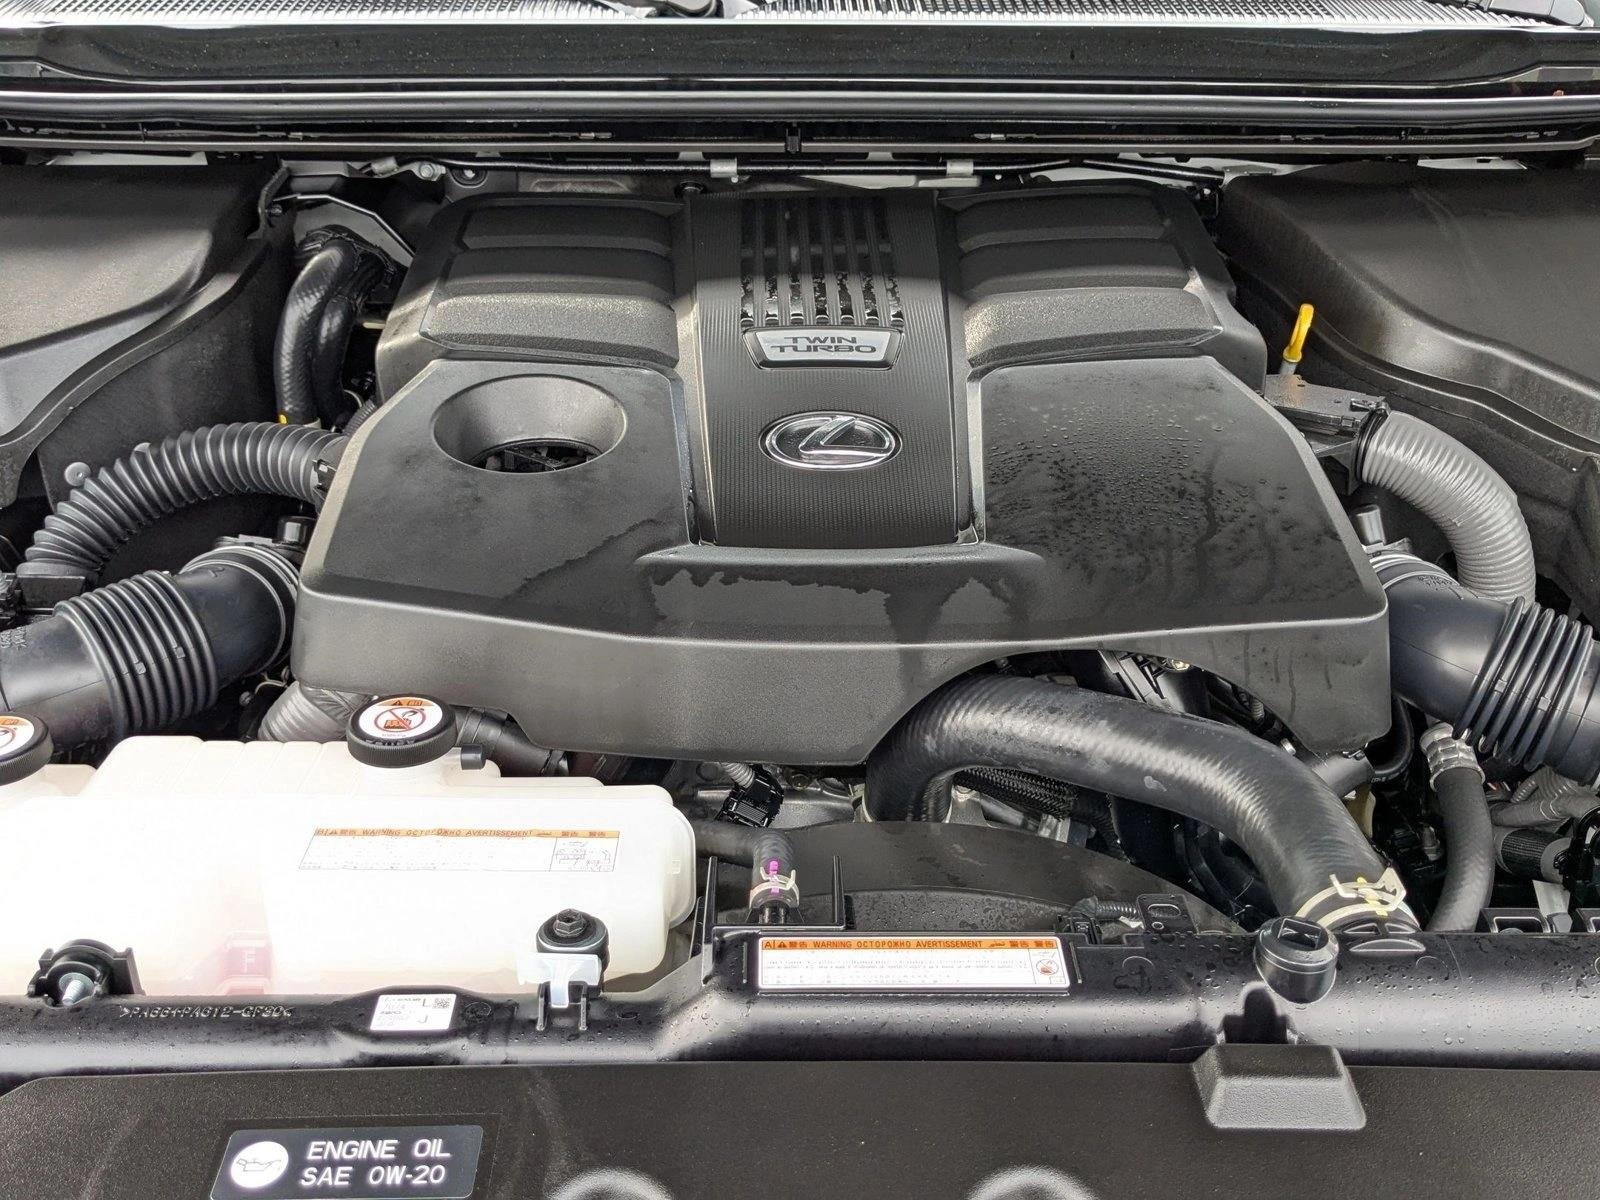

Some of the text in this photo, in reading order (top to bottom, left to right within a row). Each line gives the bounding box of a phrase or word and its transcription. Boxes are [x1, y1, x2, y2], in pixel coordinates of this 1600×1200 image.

[784, 336, 857, 344] TWIN
[771, 345, 877, 354] TURBO
[813, 940, 853, 949] WARNING
[915, 940, 983, 948] AVERTISSEMENT
[306, 1138, 450, 1160] ENGINE OIL
[300, 1166, 353, 1186] SAE
